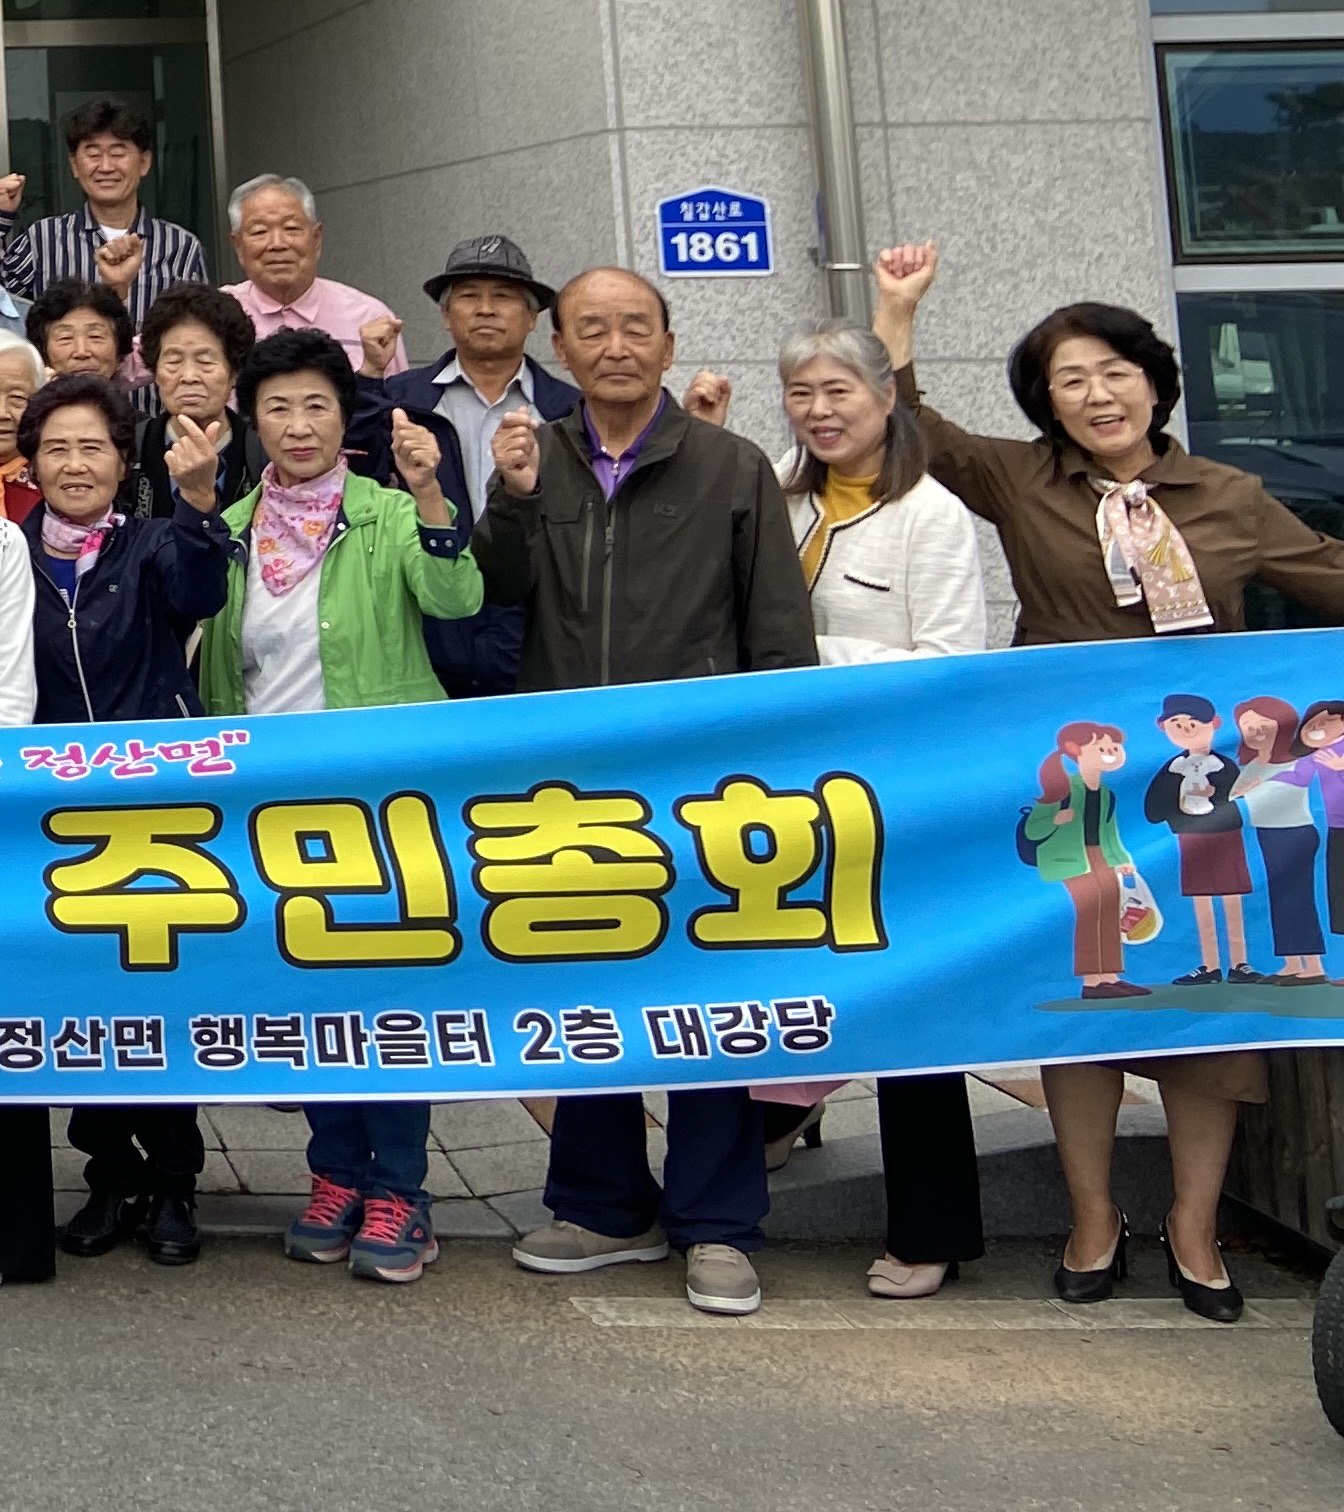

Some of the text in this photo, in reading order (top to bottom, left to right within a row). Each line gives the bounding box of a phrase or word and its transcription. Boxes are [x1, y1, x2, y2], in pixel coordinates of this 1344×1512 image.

[680, 201, 743, 221] 칠갑산로
[670, 231, 760, 263] 1861
[42, 770, 890, 973] 주민총회
[191, 1009, 495, 1069] 행복마을터
[517, 1006, 624, 1066] 2층
[641, 995, 835, 1062] 대강당
